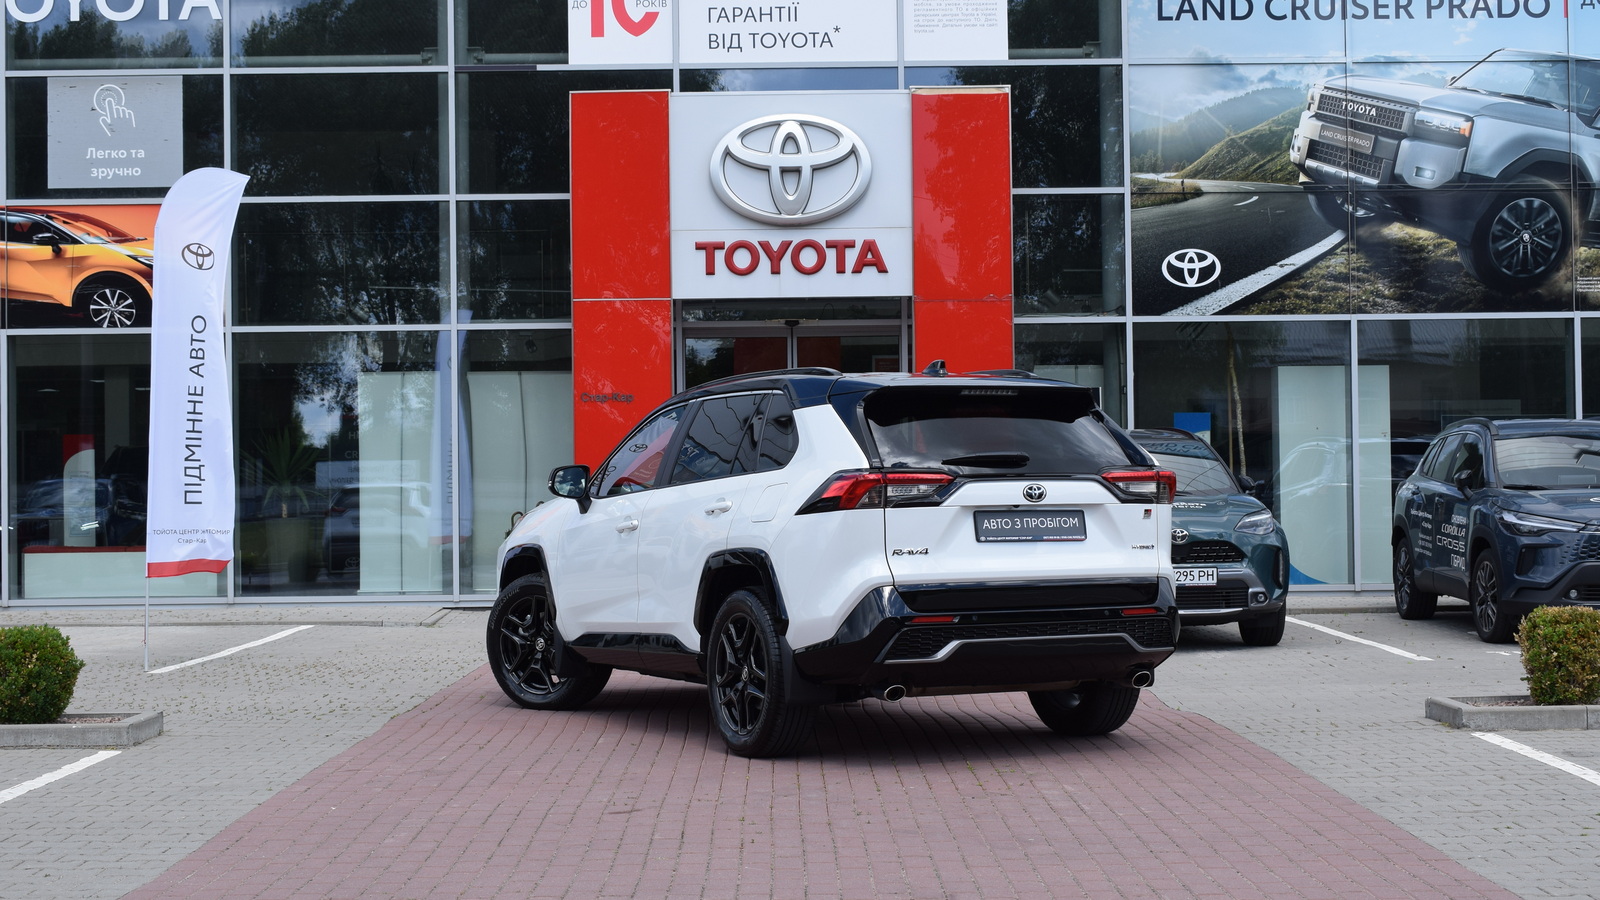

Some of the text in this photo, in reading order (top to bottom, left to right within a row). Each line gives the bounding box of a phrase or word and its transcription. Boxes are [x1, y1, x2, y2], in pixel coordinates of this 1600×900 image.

[708, 2, 800, 24] ГАРАНТІЇ
[1157, 0, 1551, 21] LAND CRUISER PRADO
[708, 33, 743, 53] ВІД
[1341, 101, 1377, 117] TOYOTA
[1320, 129, 1334, 138] LAND
[1354, 137, 1371, 148] PRADO
[86, 147, 145, 159] Легко та
[90, 167, 141, 179] зручно
[695, 238, 889, 276] TOYOTA
[581, 392, 635, 404] Стар-Кар
[184, 315, 207, 505] ПІДМІННЕ АВТО
[982, 518, 1012, 530] АВТО
[1023, 517, 1079, 529] ПРОБІГОМ
[1441, 523, 1466, 538] COROLLA
[1436, 535, 1466, 552] CROSS
[891, 547, 930, 557] RAV4
[1174, 570, 1215, 582] 295 PH
